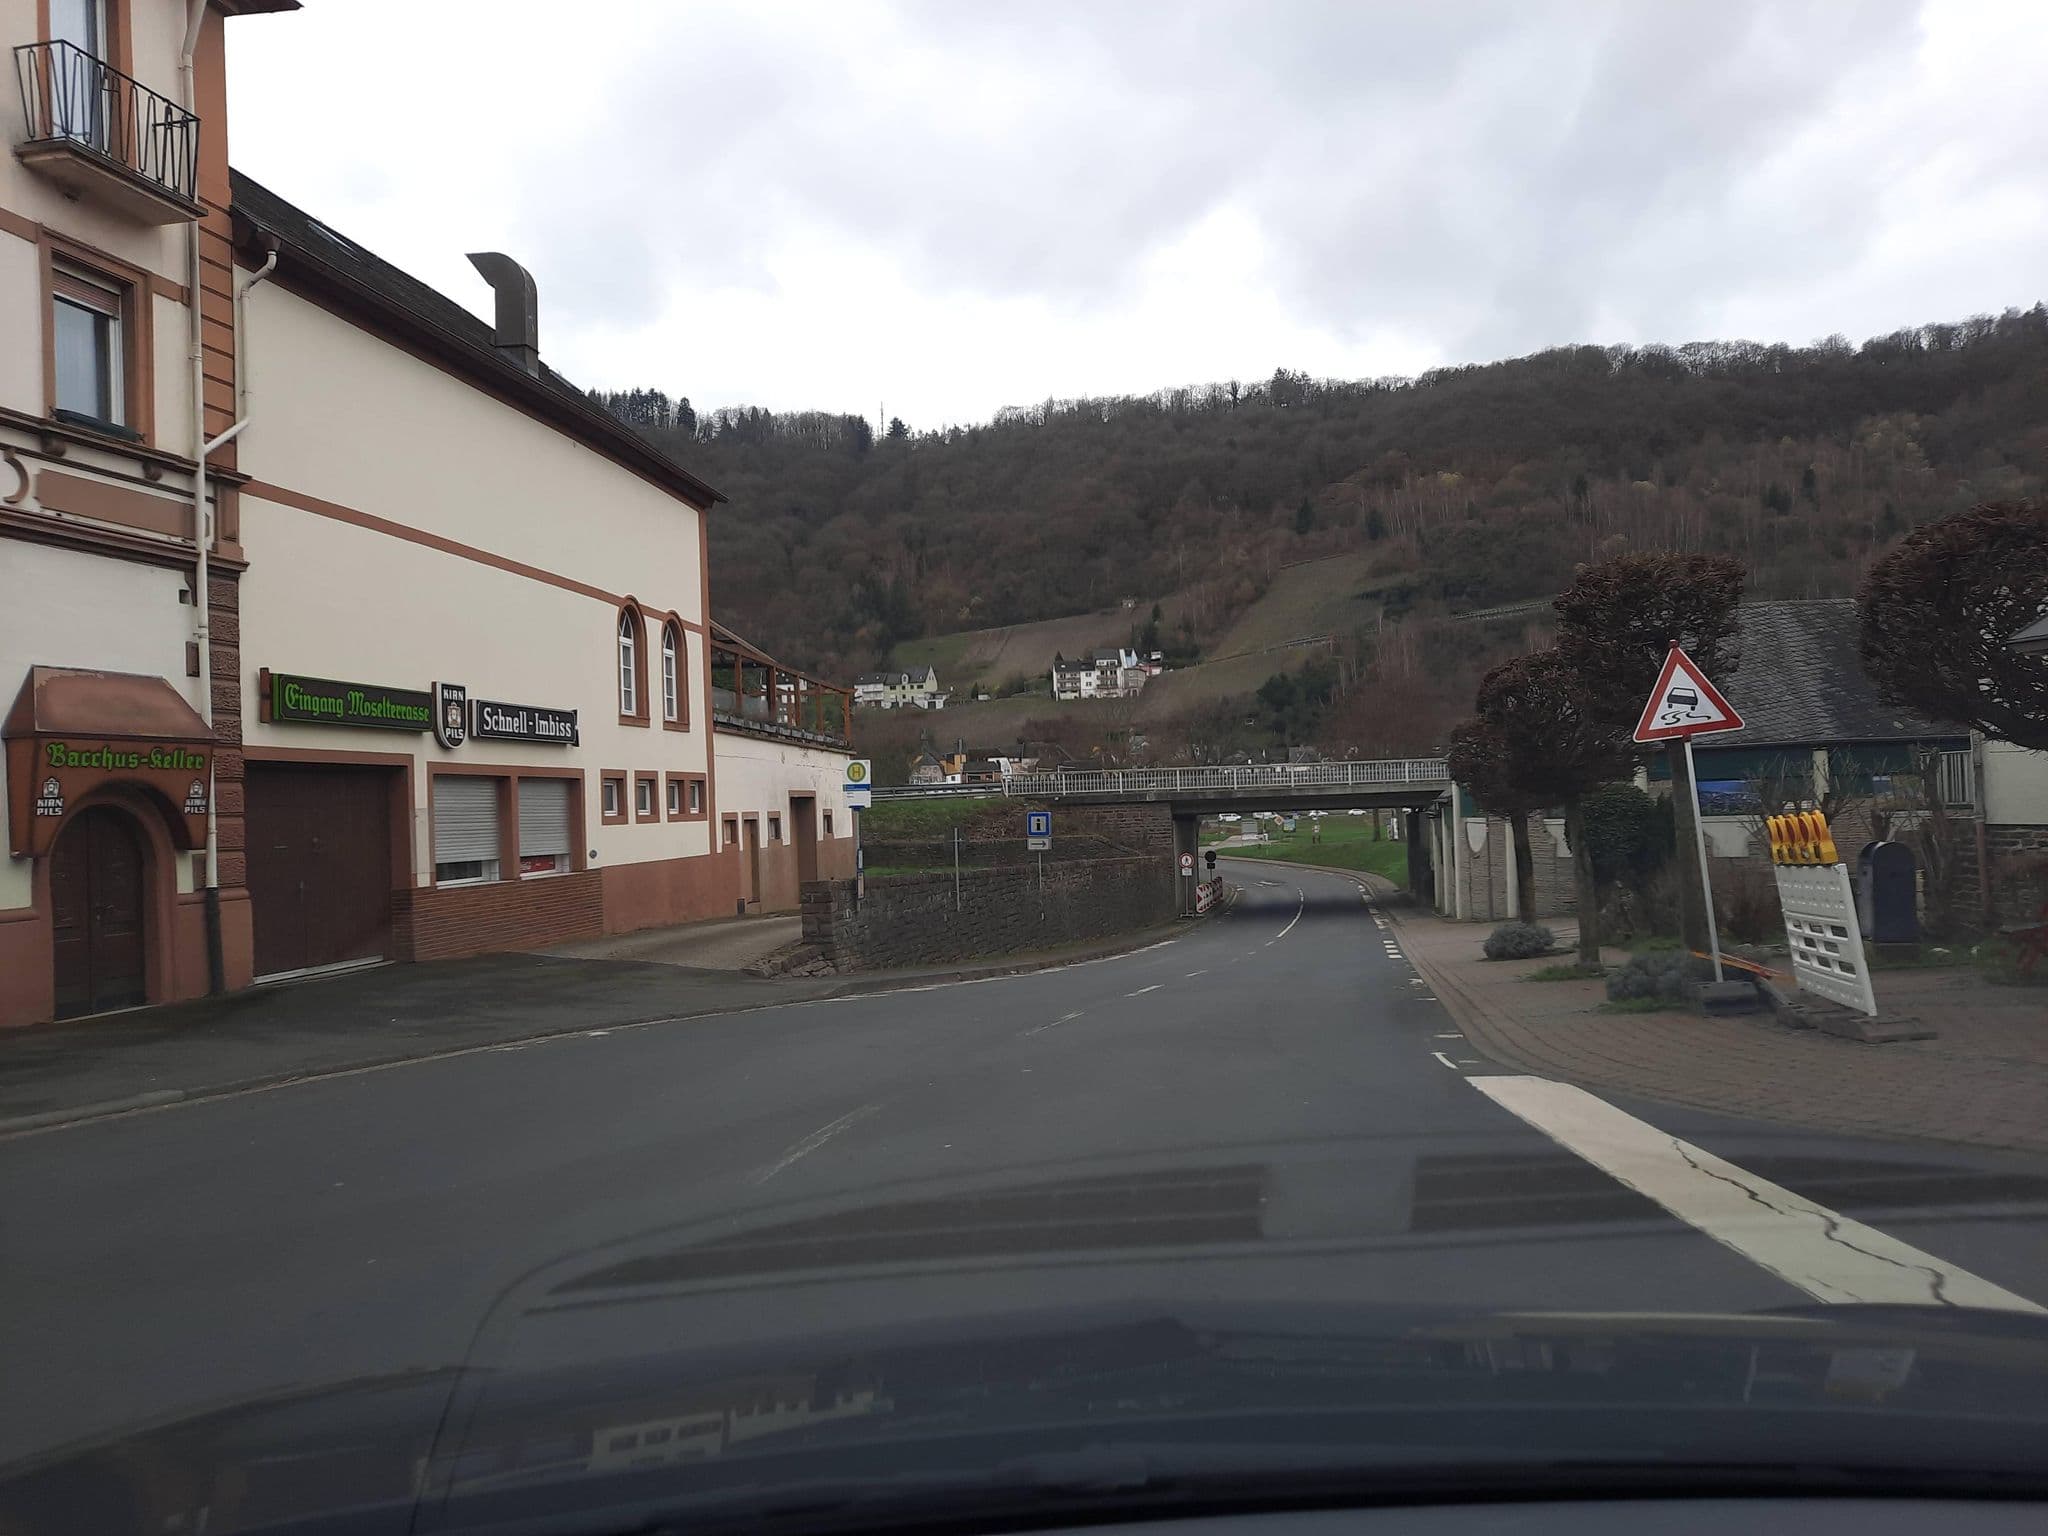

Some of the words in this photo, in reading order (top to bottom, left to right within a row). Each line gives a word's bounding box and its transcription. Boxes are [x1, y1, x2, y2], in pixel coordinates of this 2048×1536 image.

[443, 688, 465, 701] KIRN
[285, 683, 344, 717] Eingang
[347, 690, 430, 722] Moselterrasse
[445, 727, 464, 739] PILS
[47, 744, 204, 770] Bacchus-Keller
[37, 799, 64, 808] KIRN
[36, 807, 63, 816] PILS
[184, 806, 206, 814] PILS
